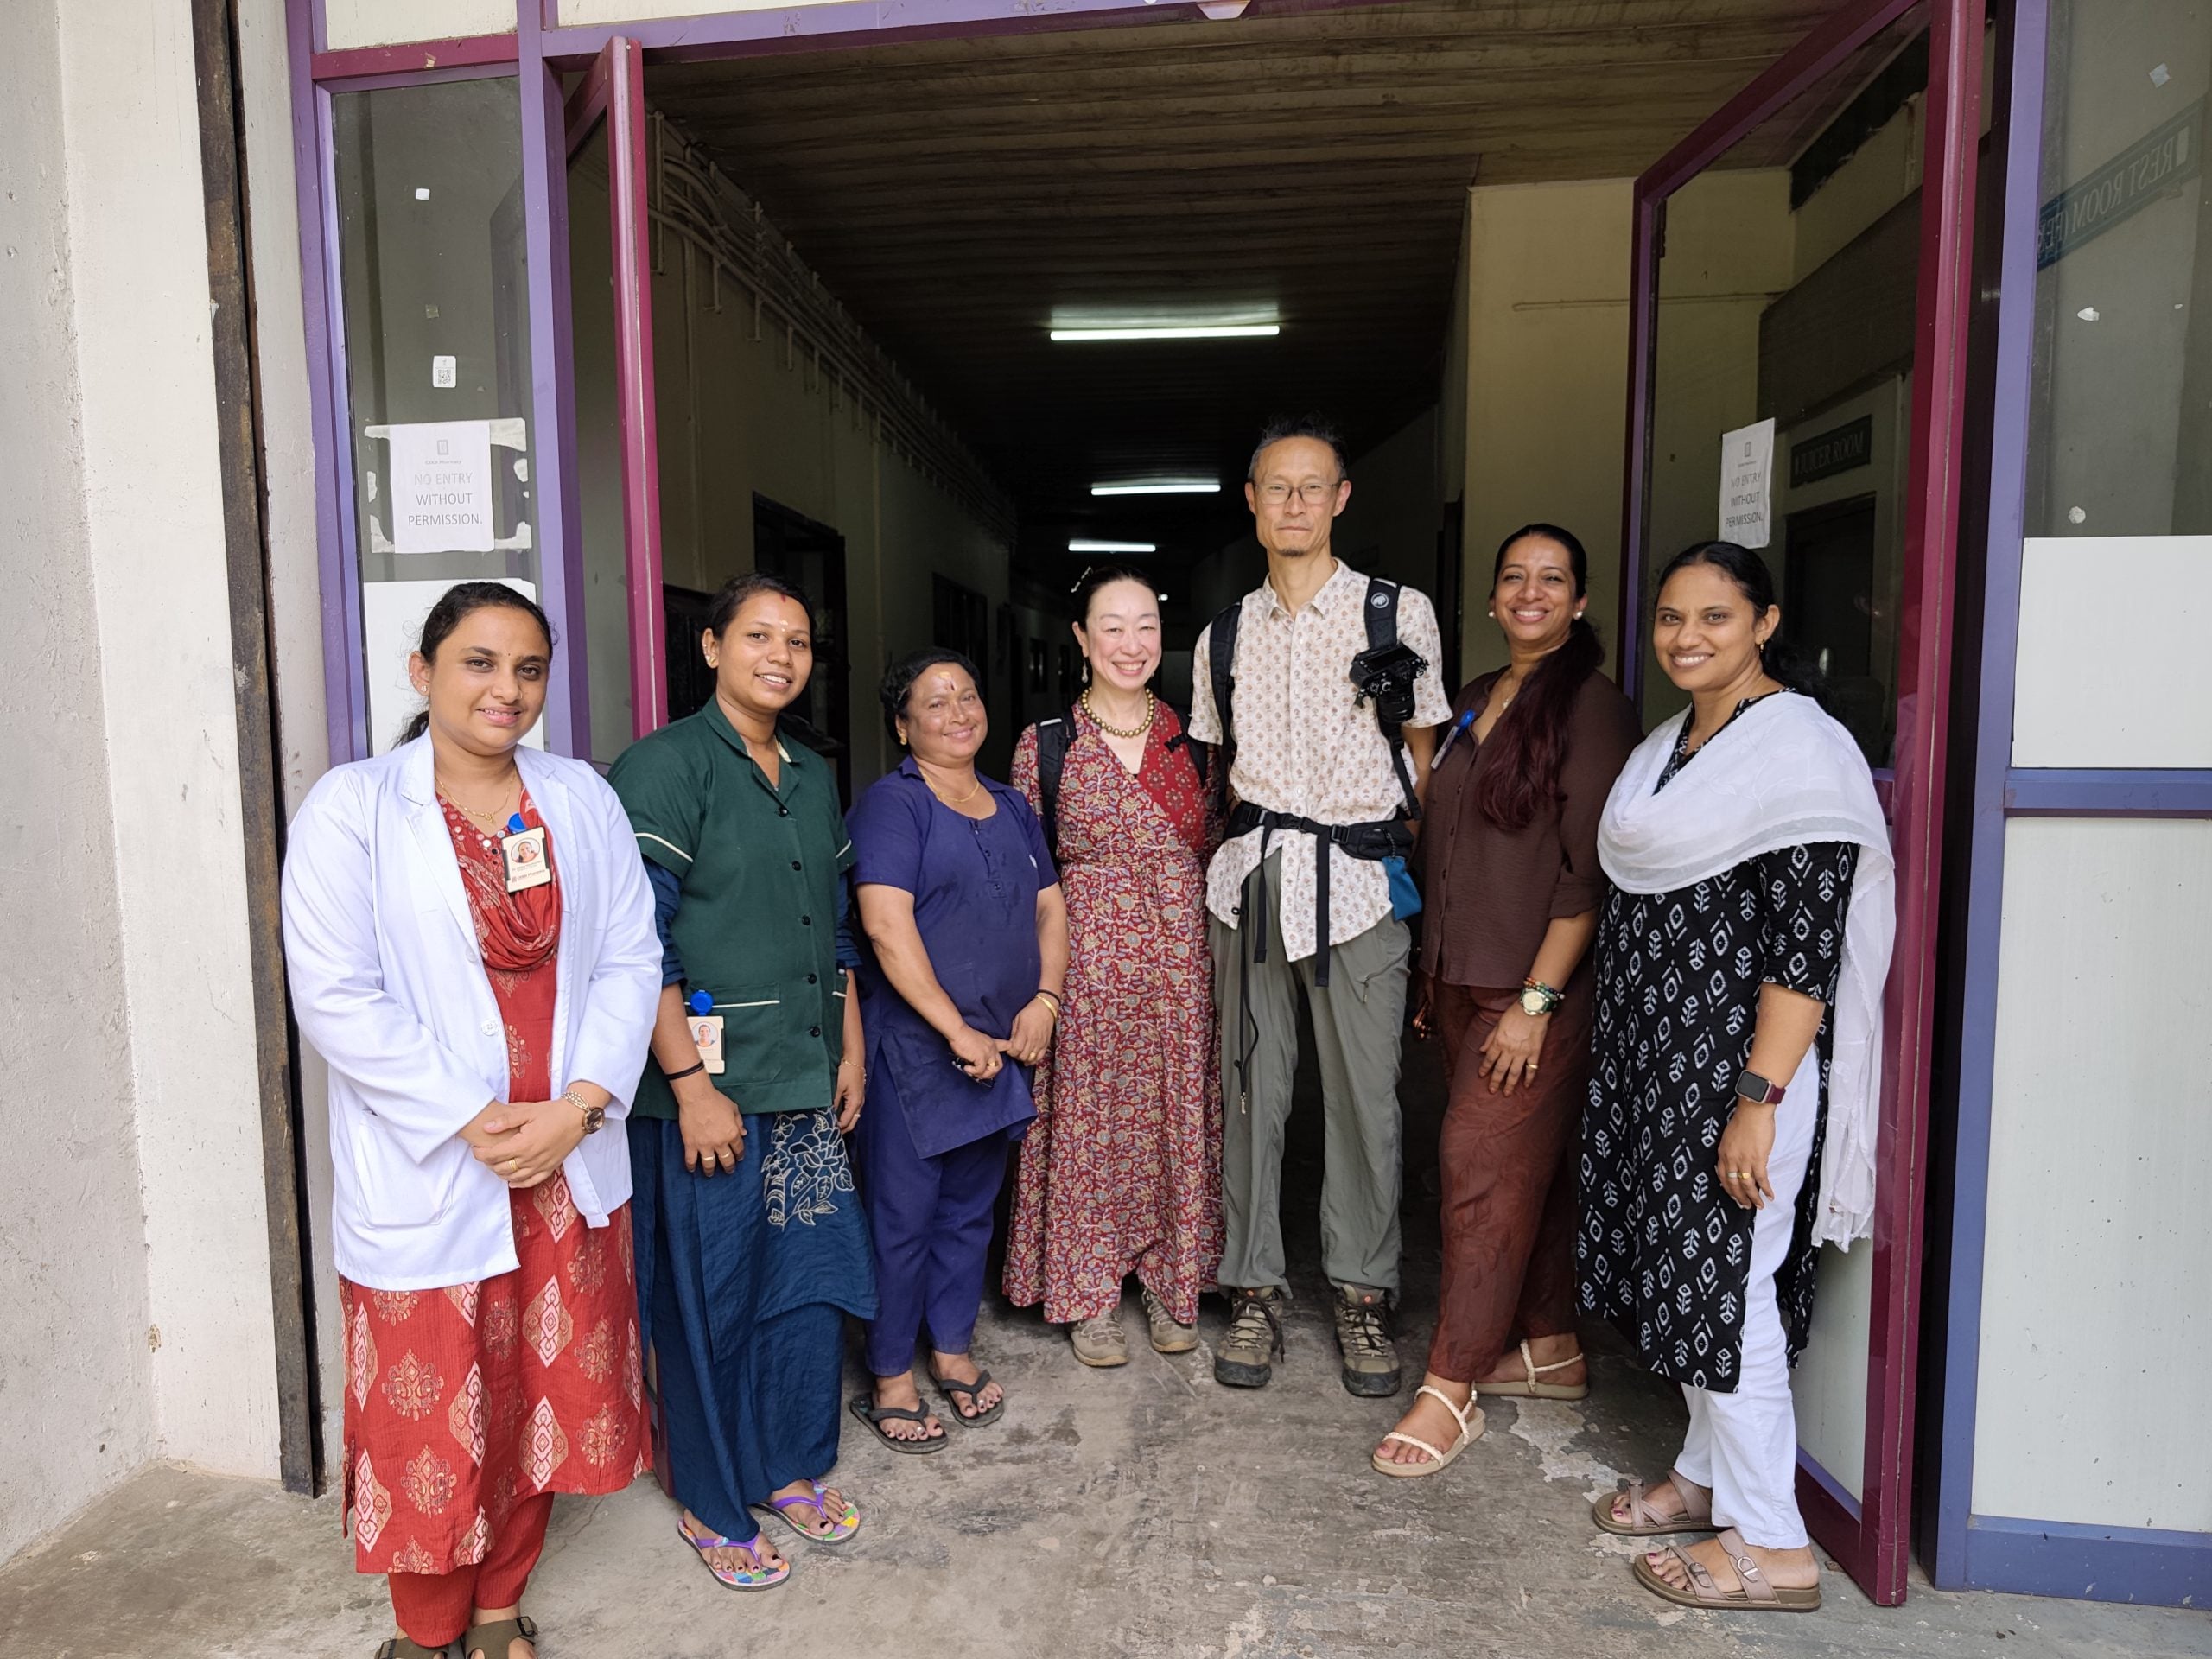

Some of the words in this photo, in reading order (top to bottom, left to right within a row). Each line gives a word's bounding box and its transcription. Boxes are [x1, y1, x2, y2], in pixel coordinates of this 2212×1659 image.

[1830, 432, 1863, 461] ROOM
[414, 473, 432, 486] NO
[435, 472, 473, 485] ENTRY
[1730, 477, 1740, 489] NO
[1741, 471, 1762, 486] ENTRY
[416, 493, 473, 505] WITHOUT
[1730, 491, 1760, 508] WITHOUT
[408, 513, 483, 526] PERMISSION.
